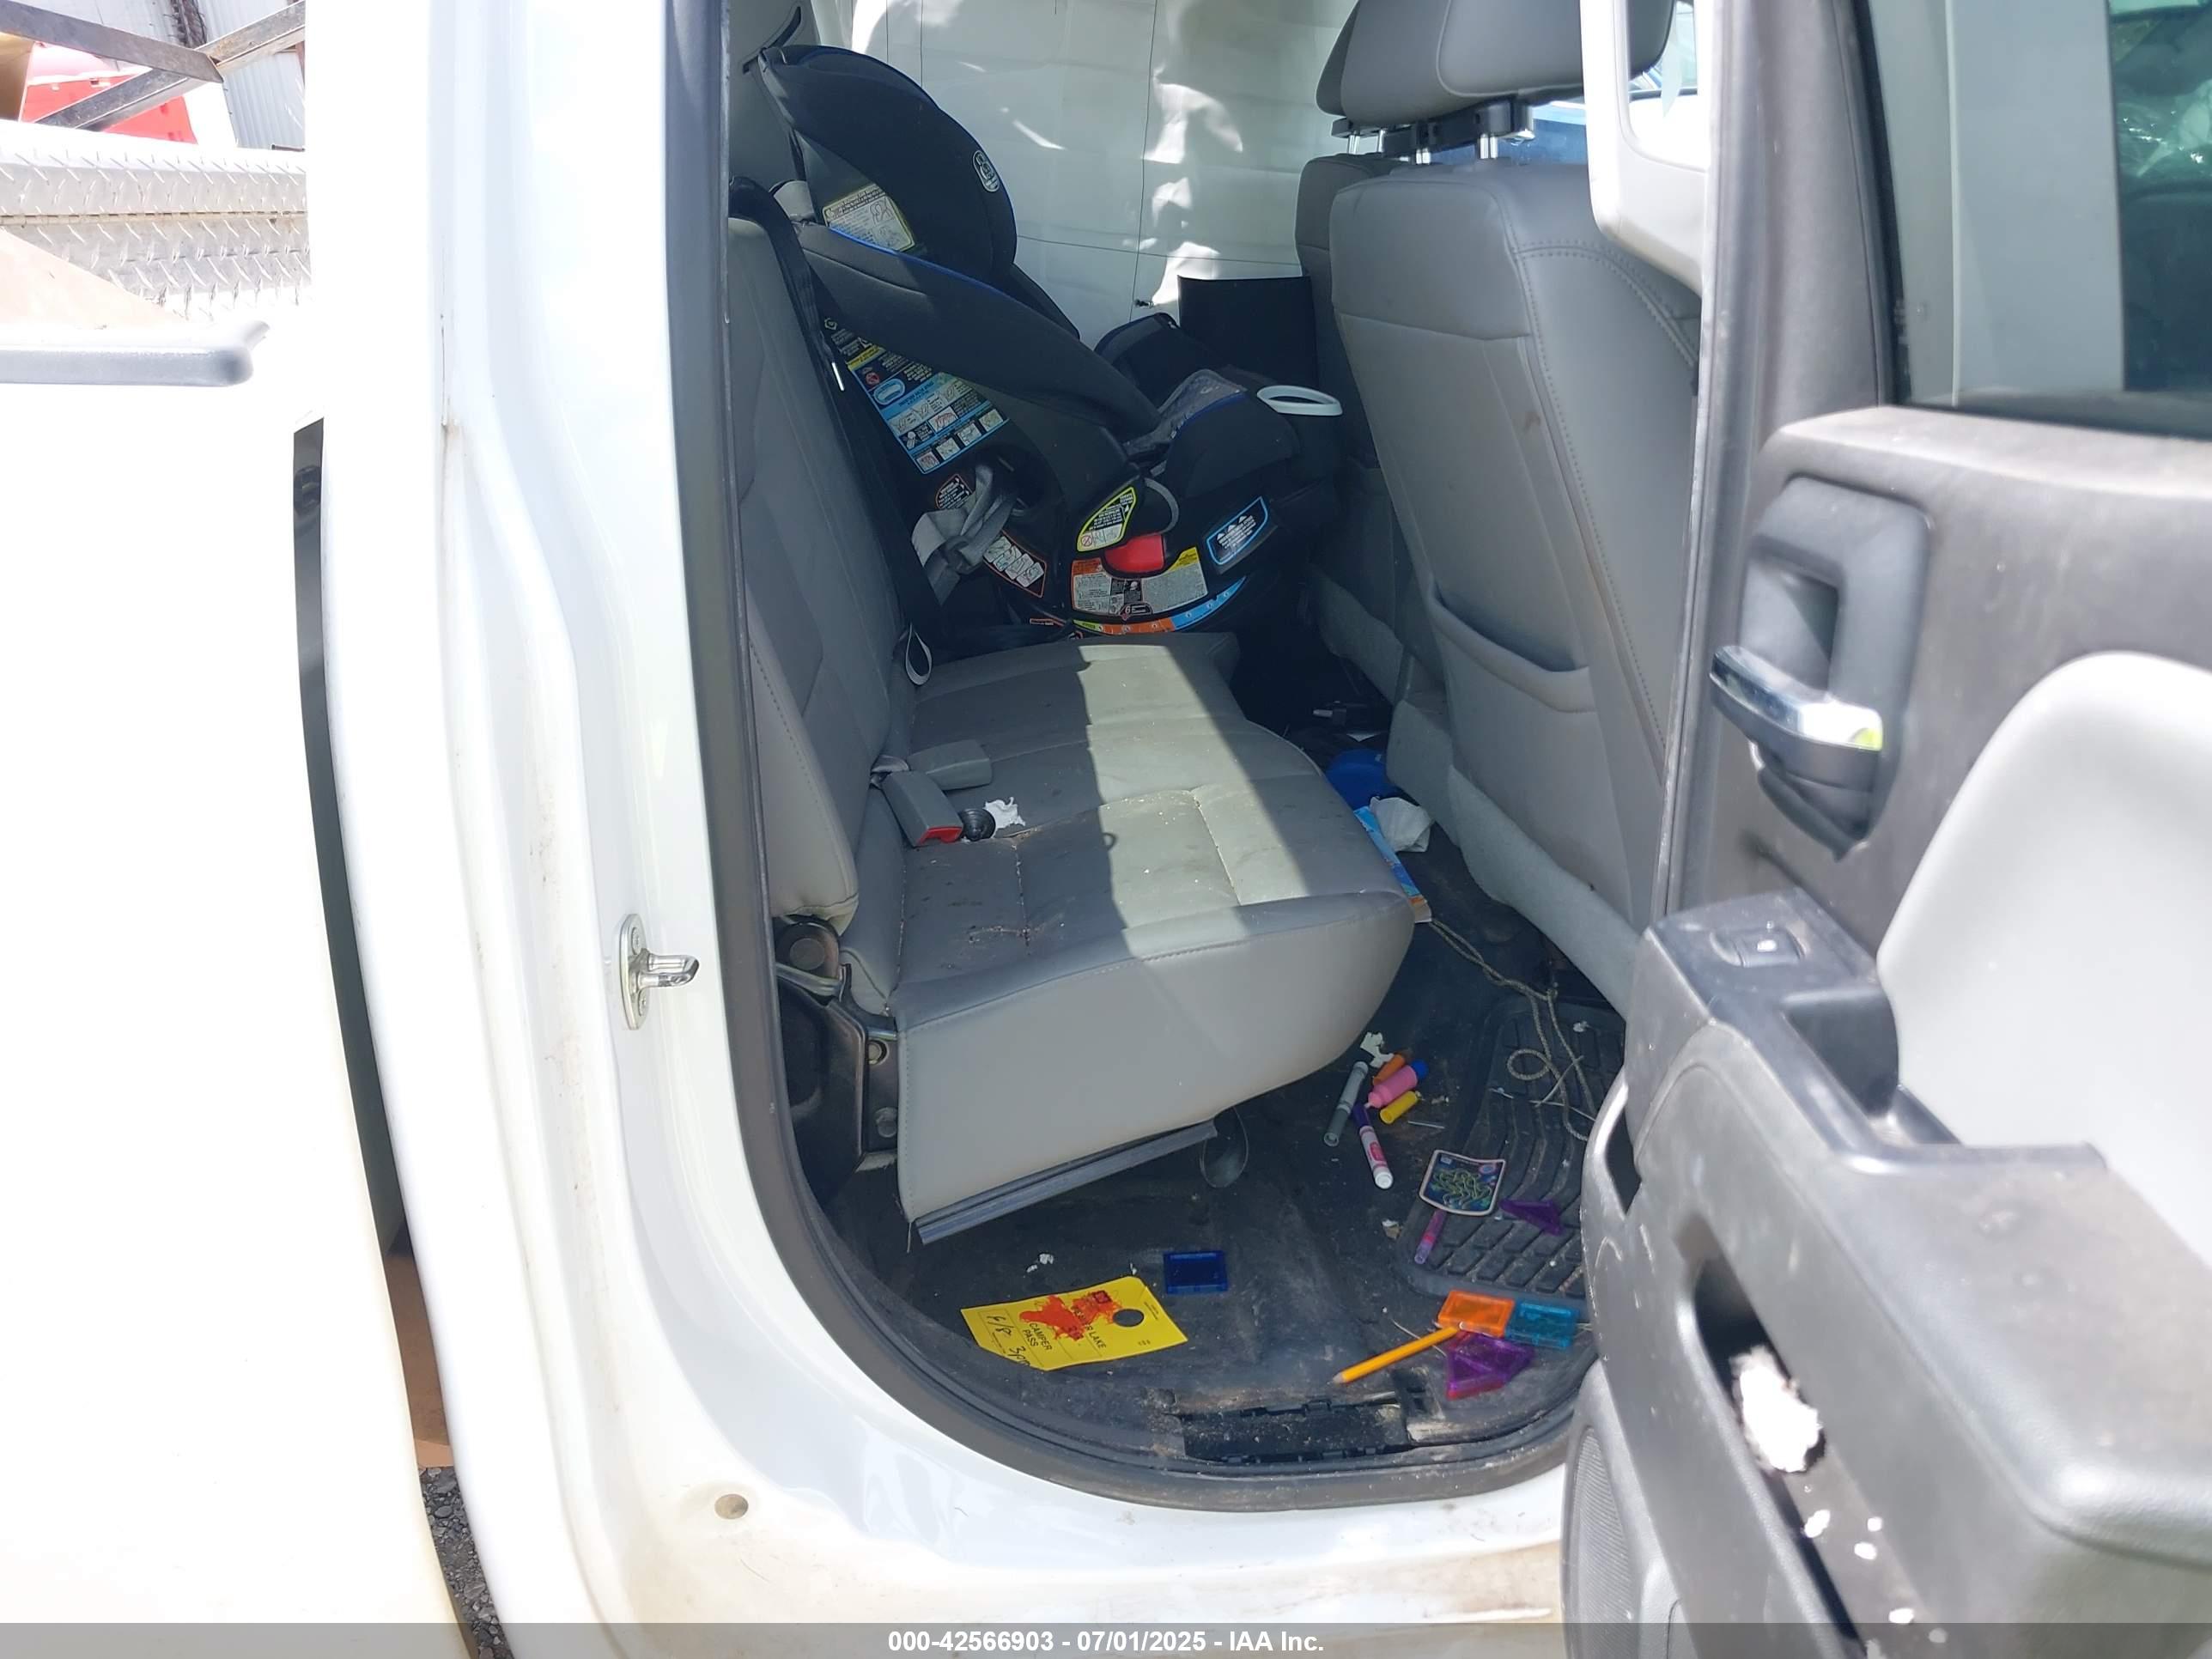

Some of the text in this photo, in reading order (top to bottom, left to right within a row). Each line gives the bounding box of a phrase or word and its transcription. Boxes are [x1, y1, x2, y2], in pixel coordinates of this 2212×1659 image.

[1022, 1329, 1039, 1346] PASS
[1029, 1323, 1053, 1351] CAMPER
[1088, 1331, 1107, 1349] LAKE
